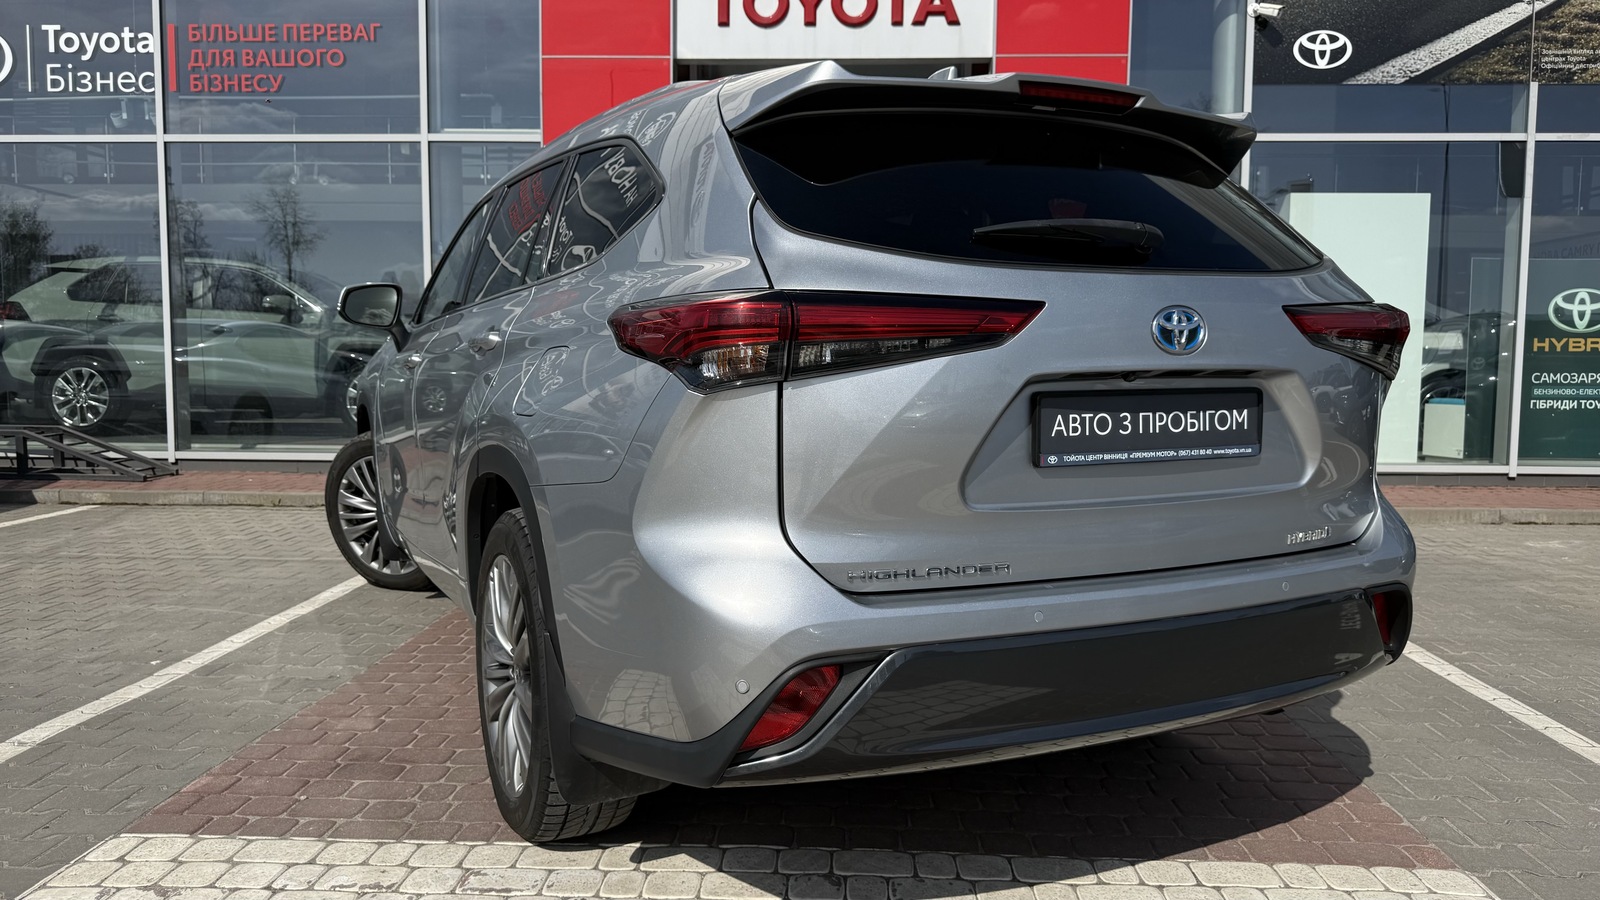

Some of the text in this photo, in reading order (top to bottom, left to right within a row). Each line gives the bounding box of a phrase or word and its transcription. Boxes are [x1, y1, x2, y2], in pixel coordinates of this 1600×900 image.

[187, 22, 381, 42] БІЛЬШЕ ПЕРЕВАГ
[41, 24, 154, 61] Toyota
[187, 48, 345, 70] ДЛЯ ВАШОГО
[46, 63, 155, 92] Бізнес
[189, 73, 284, 93] БІЗНЕСУ
[1533, 337, 1600, 352] HYBR
[1530, 399, 1578, 411] ГІБРИДИ
[1051, 412, 1113, 437] АВТО
[1139, 408, 1248, 434] ПРОБІГОМ
[1063, 454, 1086, 462] ТОЙОТА
[1085, 453, 1103, 462] ЦЕНТР
[1103, 452, 1128, 460] ВІННИЦЯ
[848, 562, 1012, 582] HIGHLANDER
